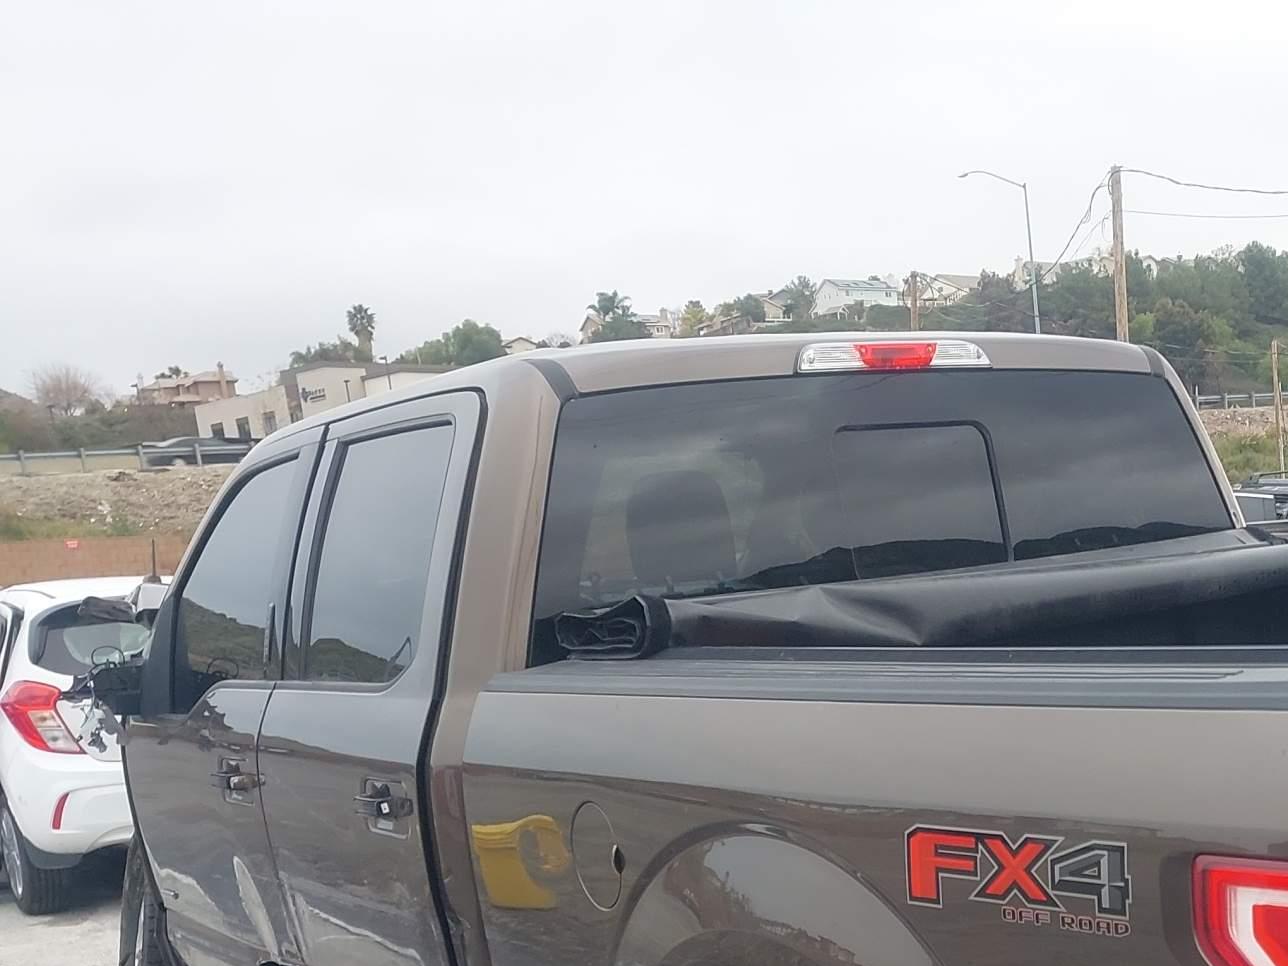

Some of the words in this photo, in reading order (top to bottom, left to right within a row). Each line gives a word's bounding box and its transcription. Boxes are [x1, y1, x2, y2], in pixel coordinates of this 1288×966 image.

[904, 823, 1132, 920] FX4
[1001, 905, 1051, 926] OFF
[1059, 913, 1131, 937] ROAD
